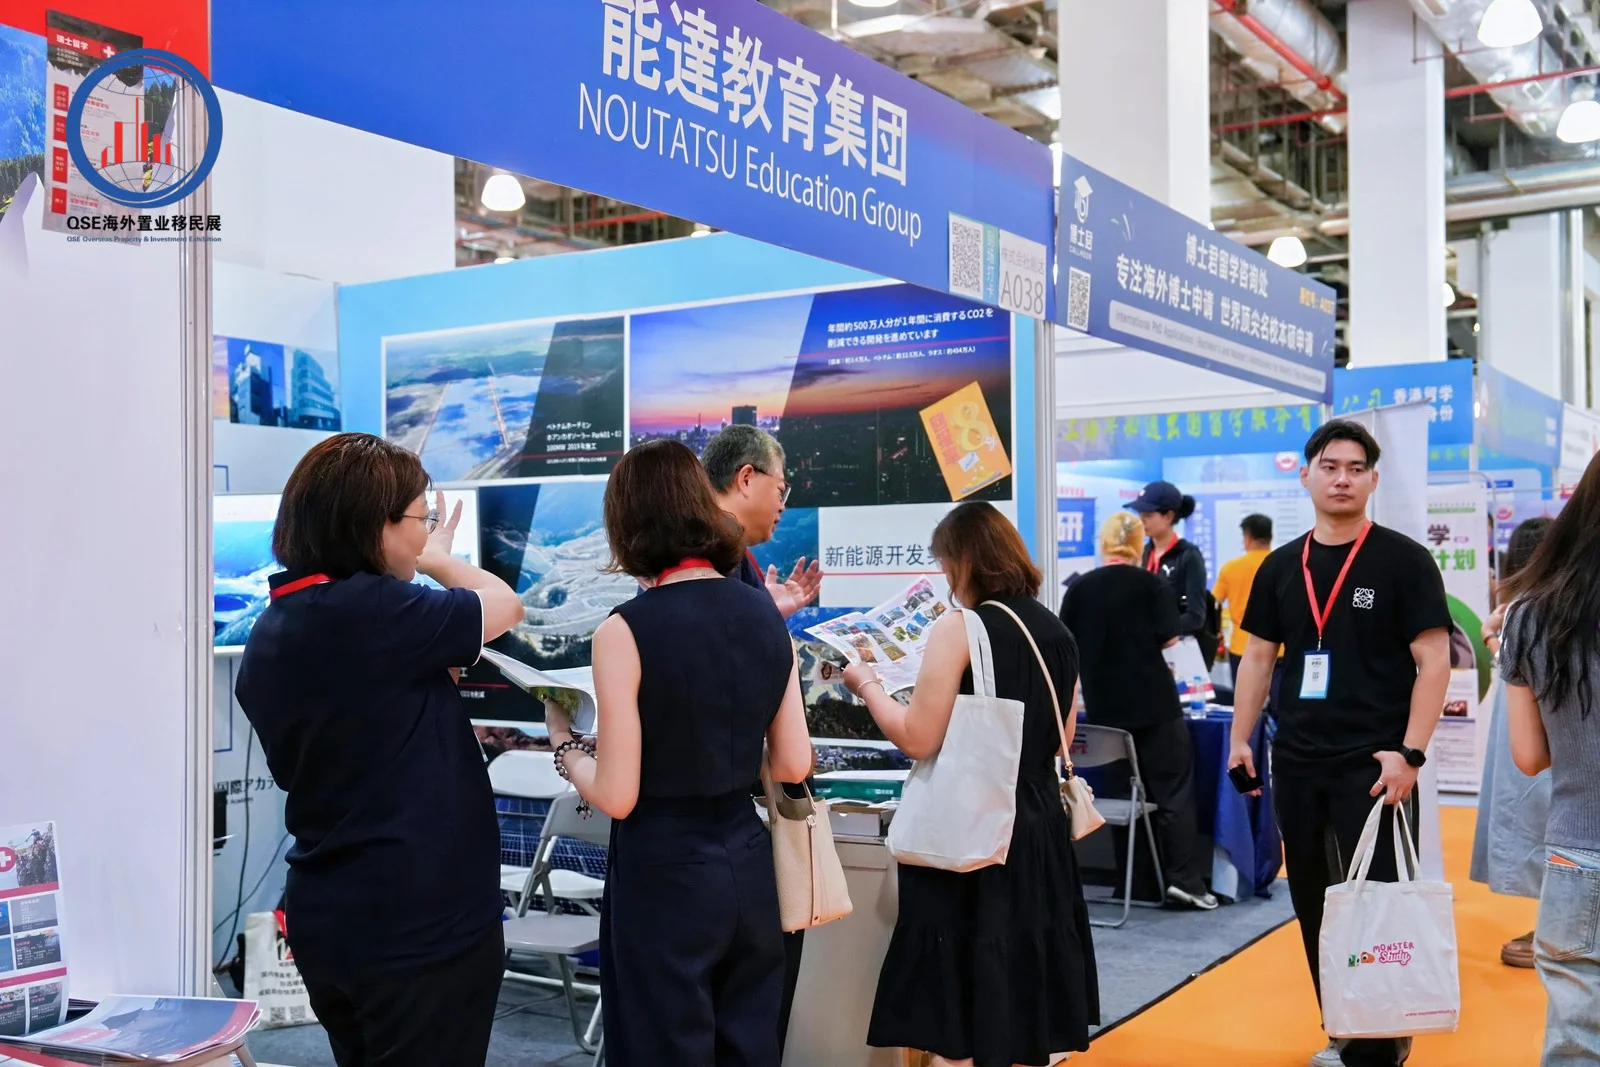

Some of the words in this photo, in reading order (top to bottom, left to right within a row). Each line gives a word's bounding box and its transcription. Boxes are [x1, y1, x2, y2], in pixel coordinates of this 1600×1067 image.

[578, 82, 738, 180] NOUTATSU
[745, 145, 857, 221] Education
[862, 187, 922, 247] Group
[1000, 269, 1044, 316] A038
[1115, 253, 1214, 322] 专注海外博士申请
[1185, 232, 1269, 299] 博士君留学咨询处
[1373, 941, 1415, 953] MONSTER
